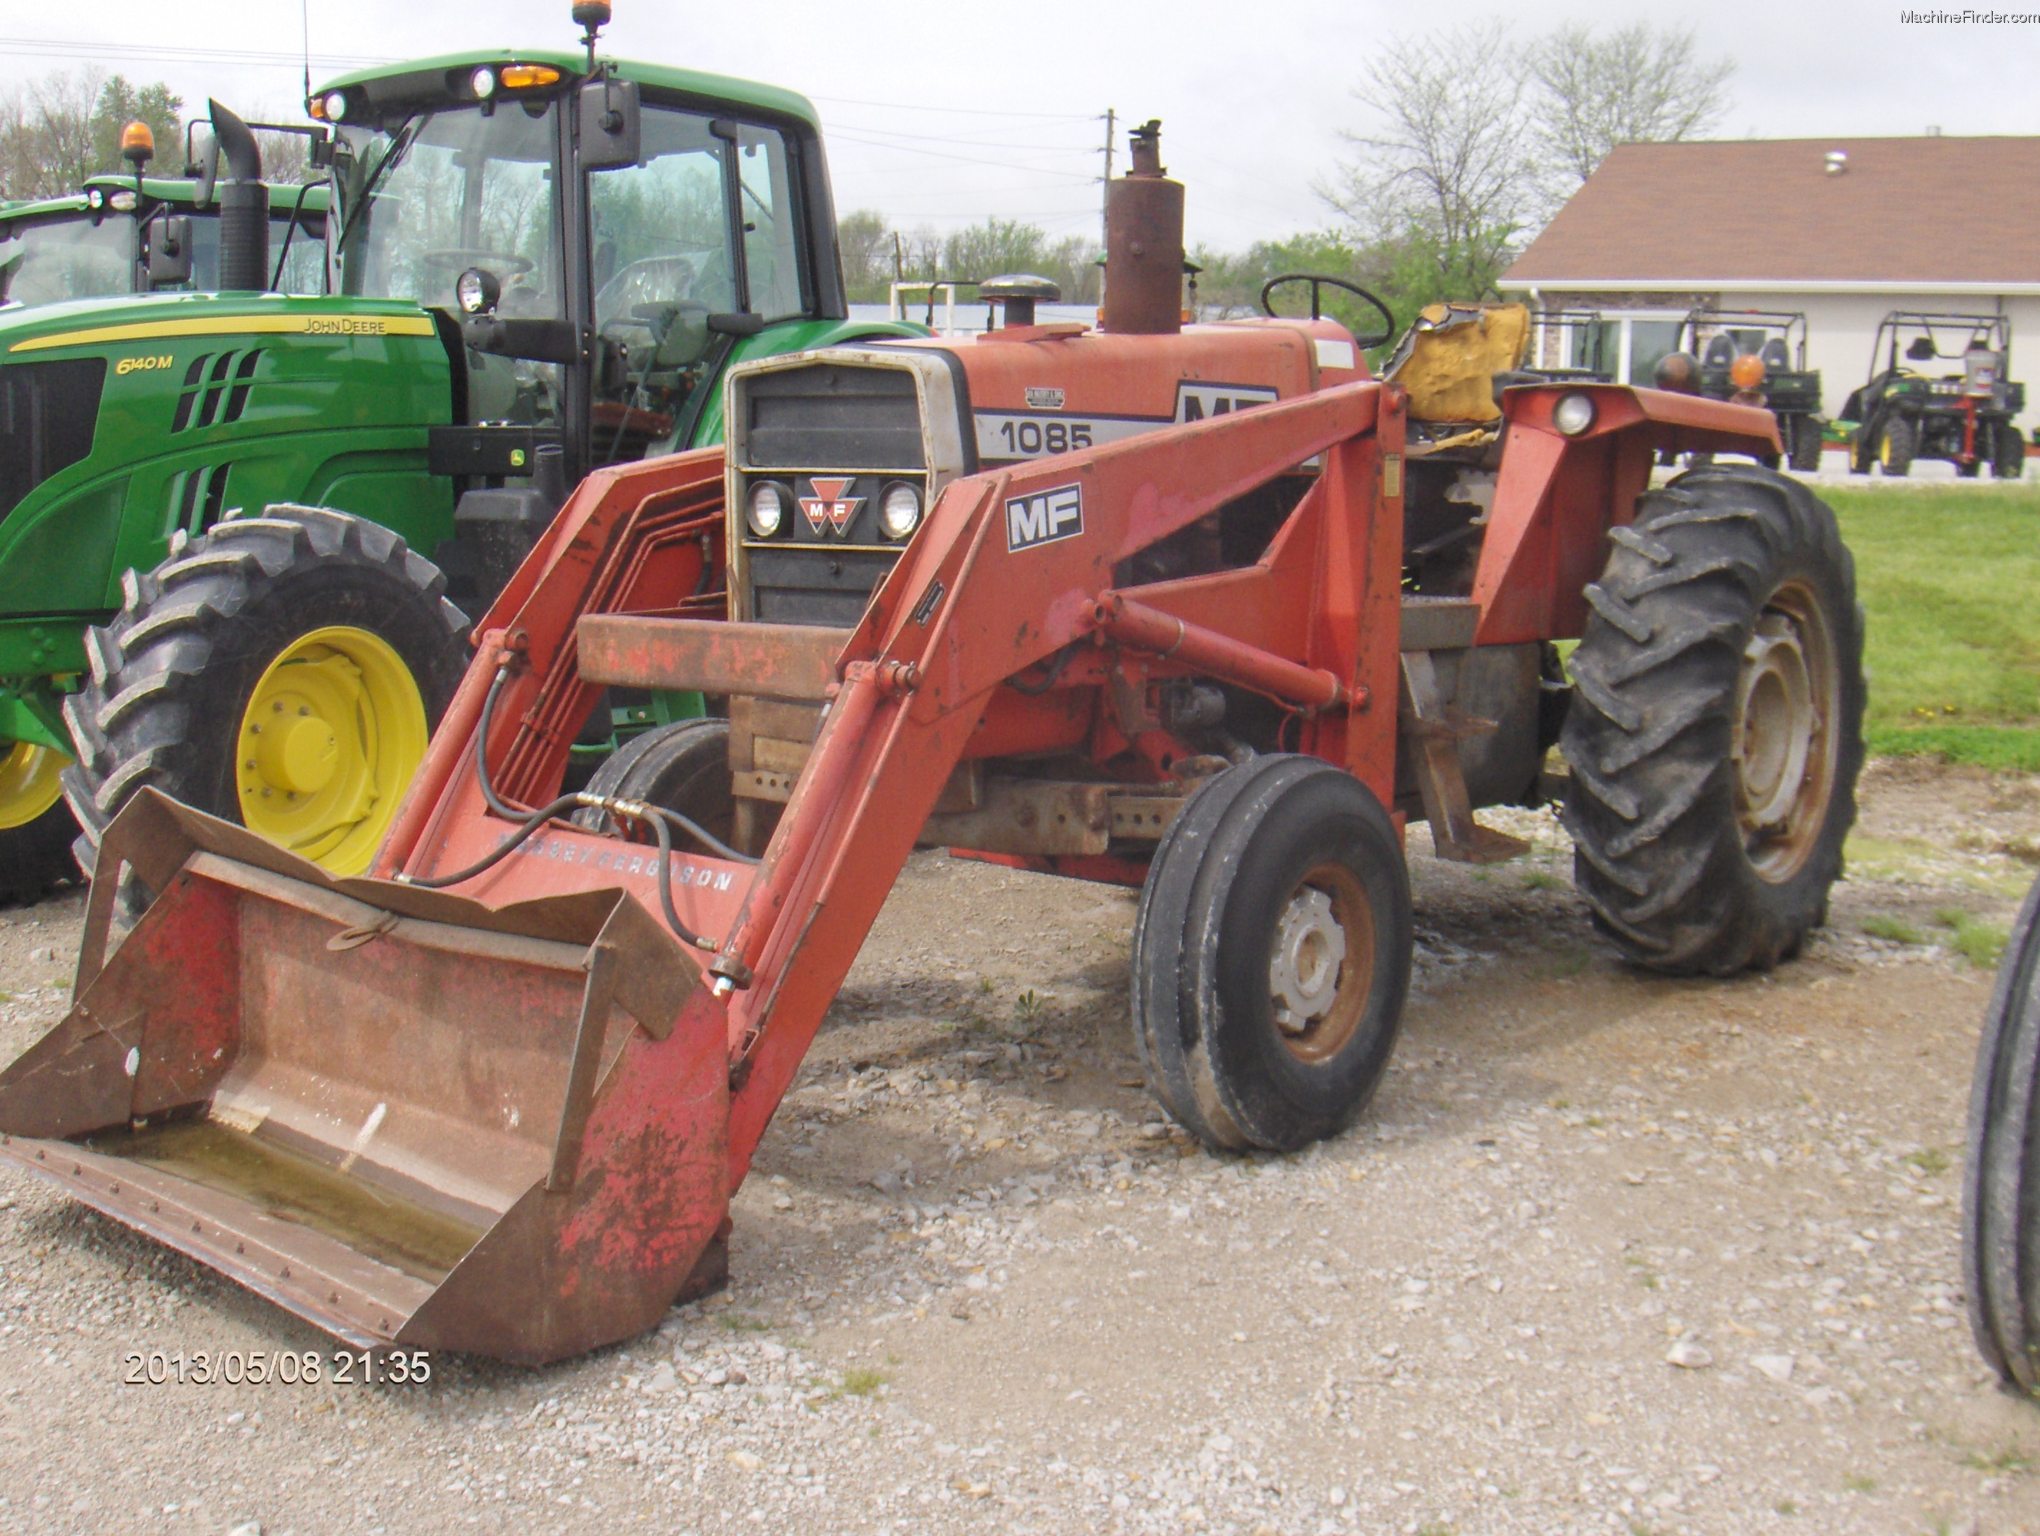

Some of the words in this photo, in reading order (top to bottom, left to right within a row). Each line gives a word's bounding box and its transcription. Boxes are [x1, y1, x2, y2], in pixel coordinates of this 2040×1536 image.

[1184, 395, 1276, 423] M
[1000, 421, 1093, 454] 1085
[1009, 489, 1078, 545] MF
